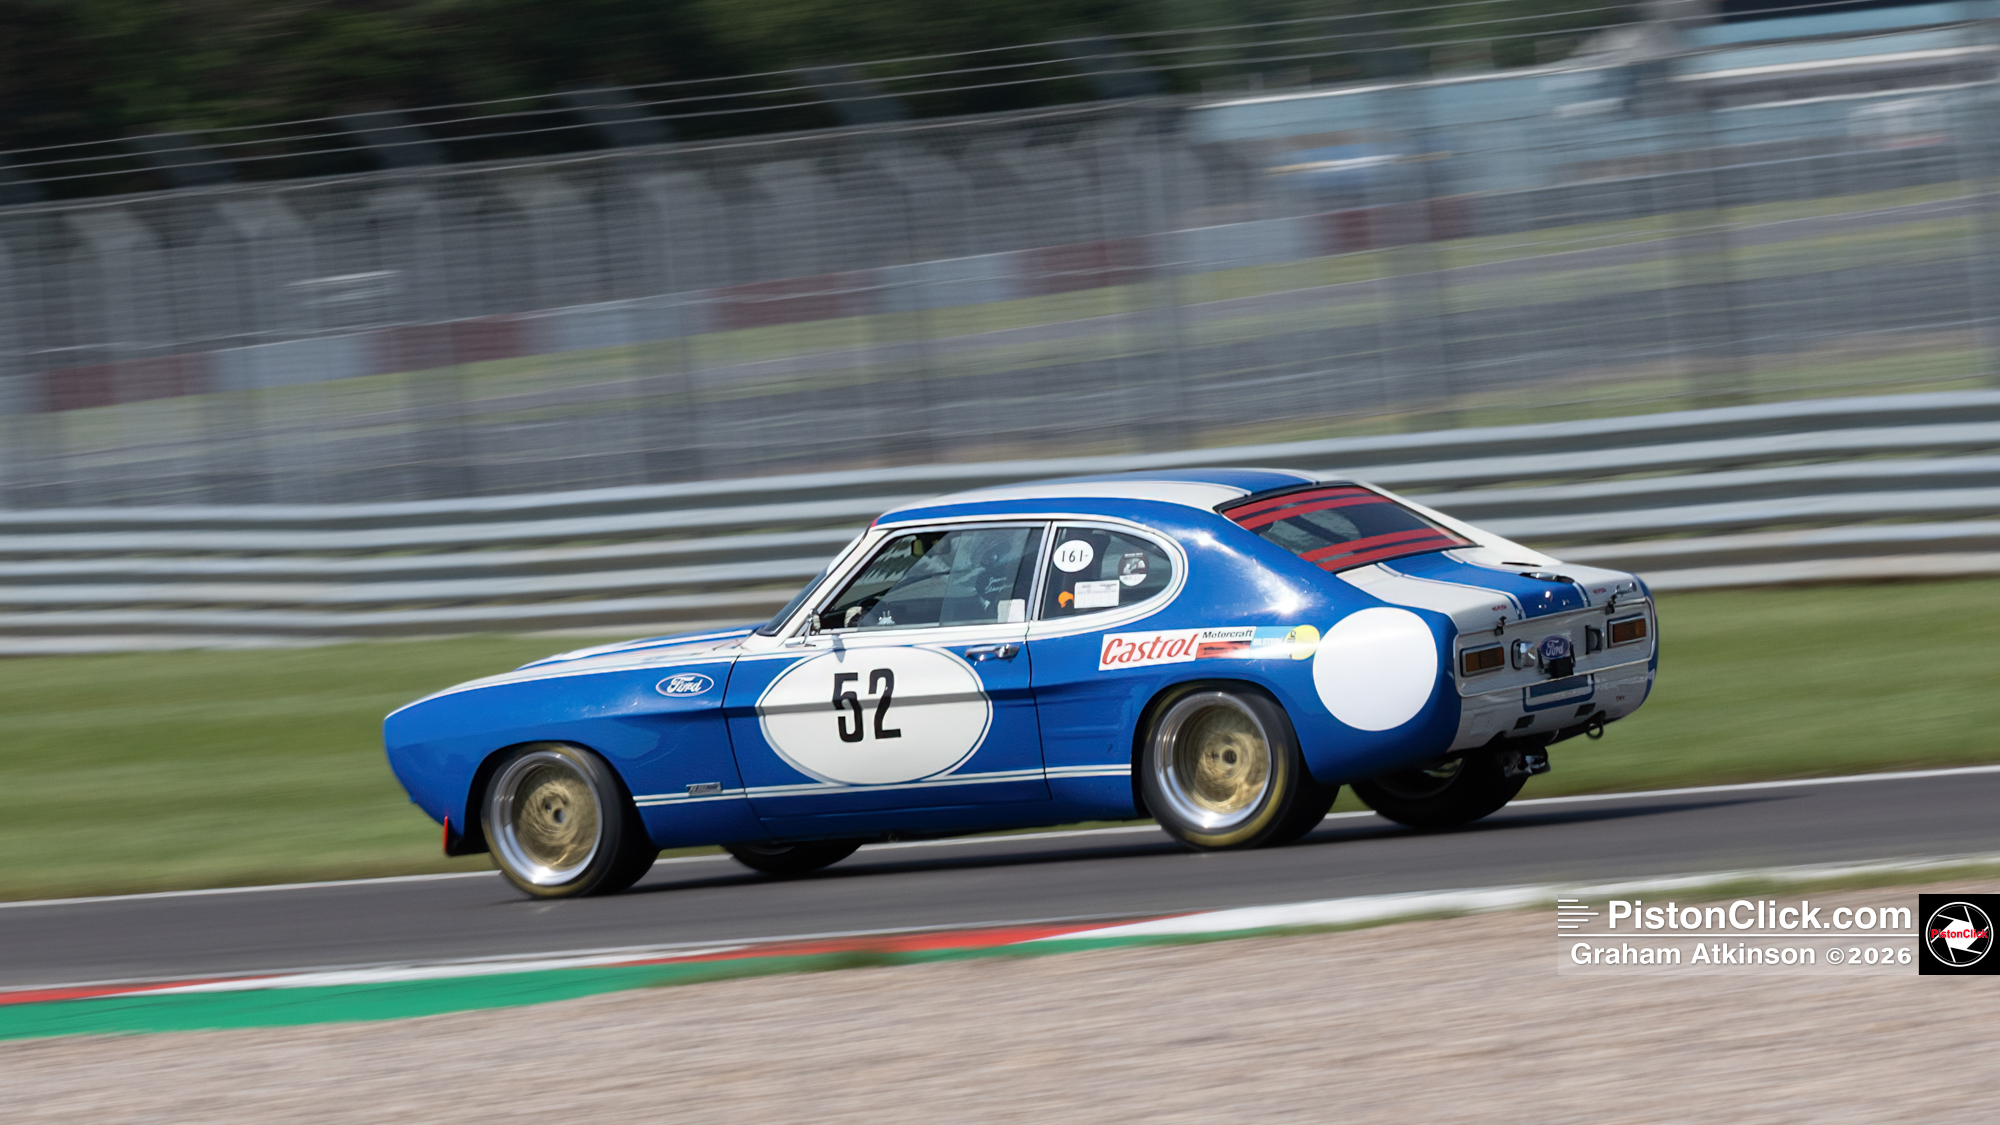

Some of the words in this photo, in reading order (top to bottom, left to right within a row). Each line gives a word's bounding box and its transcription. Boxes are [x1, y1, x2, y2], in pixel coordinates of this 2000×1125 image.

[1061, 550, 1084, 563] 161
[1202, 630, 1253, 639] Motorcraft
[1102, 633, 1199, 665] Castrol
[1544, 639, 1565, 657] Ford
[666, 676, 702, 694] Ford
[832, 668, 902, 743] 52
